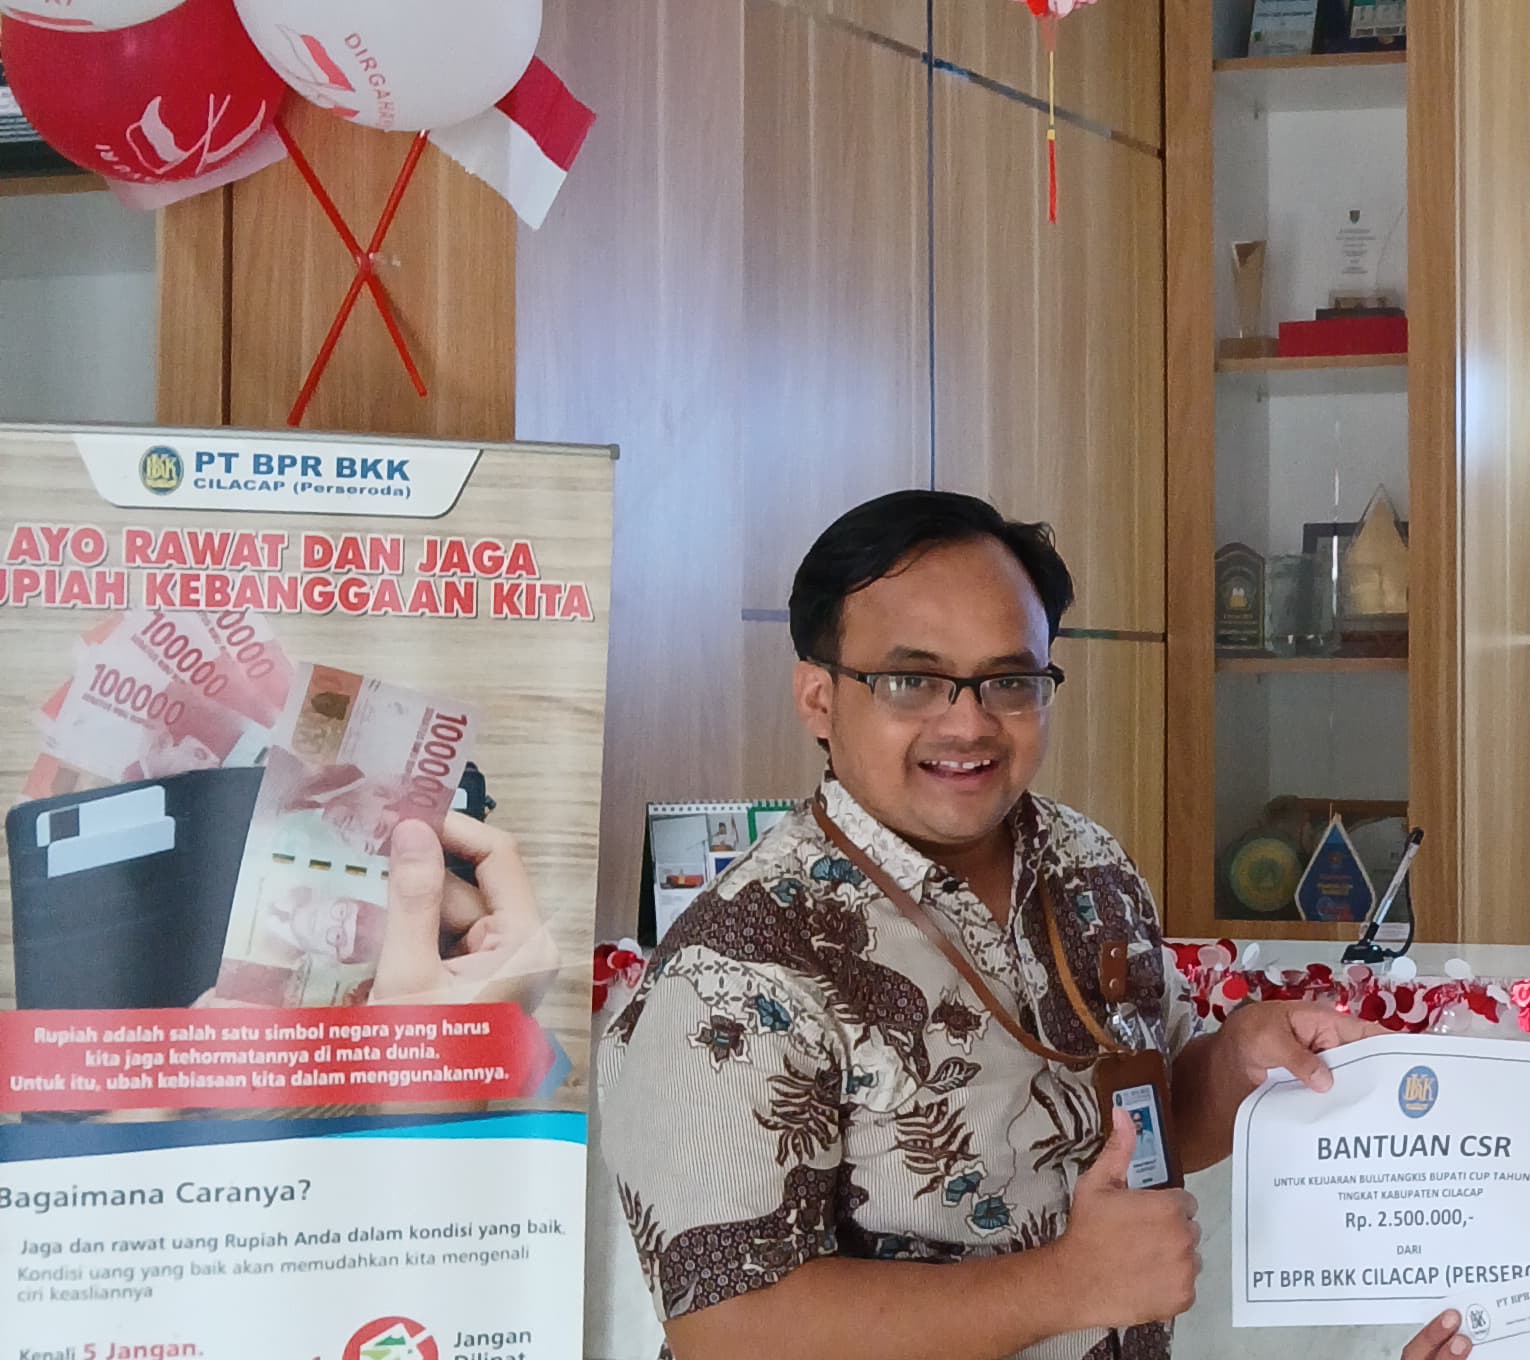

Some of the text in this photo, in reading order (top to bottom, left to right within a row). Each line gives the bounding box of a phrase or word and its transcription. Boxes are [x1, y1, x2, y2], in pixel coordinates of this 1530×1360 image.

[194, 451, 410, 481] PT BPR BKK
[193, 478, 412, 499] CILACAP (Perseroda)
[7, 527, 540, 578] AYO RAWAT DAN JAGA
[145, 572, 476, 618] KEBANGGAAN
[492, 581, 595, 622] KITA
[89, 664, 185, 725] 100000
[34, 1020, 490, 1047] Rupiah adalah salah satu simbol negara yang harus
[85, 1043, 440, 1070] kita jaga kehormatannya di mata dunia.
[10, 1074, 65, 1092] Untuk
[106, 1073, 153, 1090] ubah
[158, 1071, 247, 1088] kebiasaan
[251, 1071, 285, 1088] kita
[291, 1070, 345, 1086] dalam
[350, 1066, 509, 1086] menggunakannya.
[1317, 1134, 1512, 1160] BANTUAN CSR
[1273, 1177, 1306, 1187] UNTUK
[1359, 1173, 1427, 1184] BULUTANGKIS
[1429, 1172, 1467, 1182] BUPATI
[1469, 1172, 1490, 1181] CUP
[1493, 1172, 1530, 1182] TAHUN
[175, 1178, 313, 1209] Caranya?
[1337, 1188, 1484, 1201] TINGKAT KABUPATEN CILACAP
[1345, 1208, 1475, 1232] Rp. 2.500.000,-
[21, 1239, 63, 1259] Jaga
[69, 1237, 104, 1254] dan
[111, 1236, 165, 1252] rawat
[171, 1235, 218, 1252] uang
[225, 1231, 288, 1251] Rupiah
[294, 1230, 341, 1247] Anda
[347, 1226, 403, 1243] dalam
[409, 1222, 473, 1240] kondisi
[478, 1221, 521, 1240] yang
[1396, 1245, 1422, 1255] DARI
[17, 1244, 529, 1283] Kondisi uang yang baik akan memudahkan kita mengenali
[1253, 1271, 1274, 1288] PT
[1280, 1270, 1315, 1288] BPR
[1321, 1269, 1356, 1286] BKK
[1362, 1267, 1440, 1286] CILACAP
[17, 1288, 44, 1303] ciri
[453, 1328, 533, 1351] Jangan
